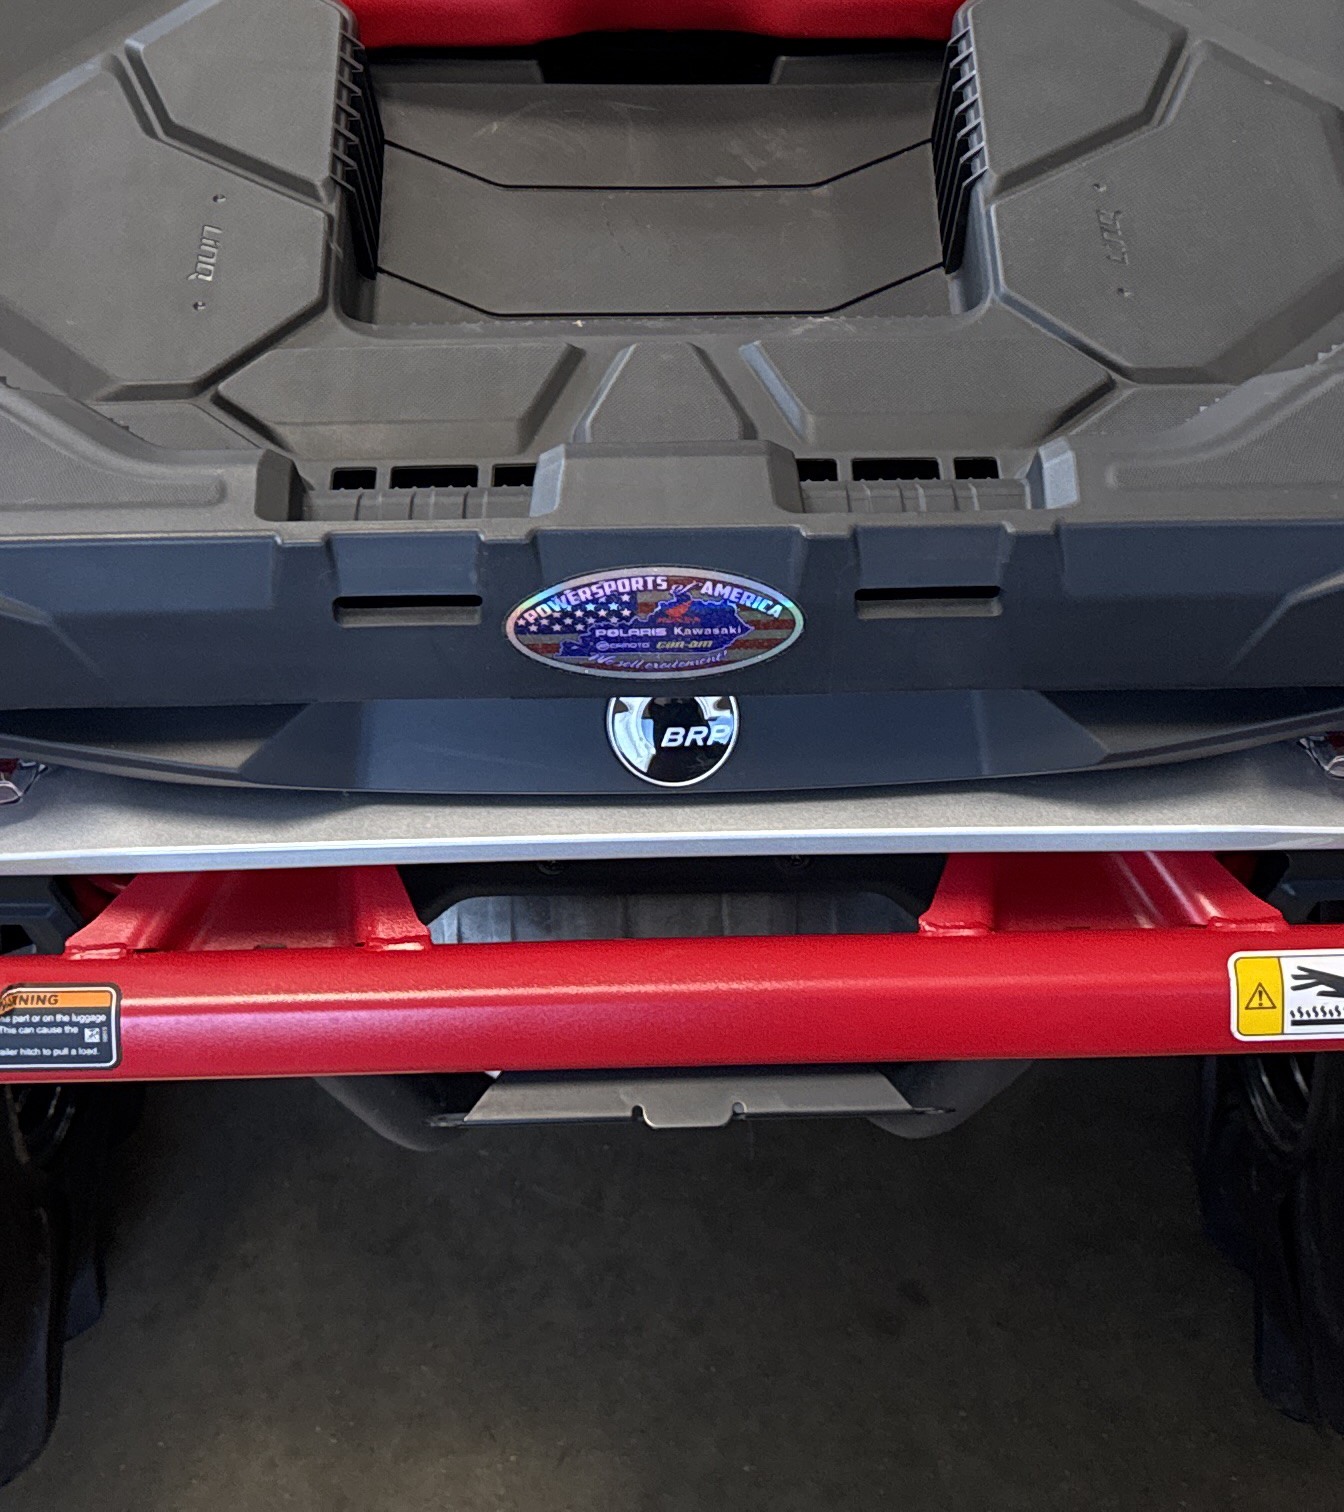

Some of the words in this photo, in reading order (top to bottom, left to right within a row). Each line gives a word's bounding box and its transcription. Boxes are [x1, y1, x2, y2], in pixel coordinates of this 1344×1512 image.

[521, 575, 668, 624] POWERSPORTS
[700, 581, 783, 619] AMERICA
[594, 627, 667, 638] POLARIS
[673, 625, 742, 636] Kawasaki
[660, 724, 732, 749] BRP
[12, 1013, 30, 1024] part
[31, 1014, 41, 1023] or
[42, 1014, 55, 1023] on
[55, 1013, 71, 1023] the
[71, 1012, 107, 1024] luggage
[18, 1026, 35, 1034] can
[35, 1026, 63, 1034] cause
[63, 1024, 79, 1034] the
[19, 1047, 42, 1056] hitch
[42, 1047, 52, 1056] to
[52, 1046, 69, 1057] pull
[70, 1048, 78, 1056] a
[77, 1046, 101, 1056] load.
